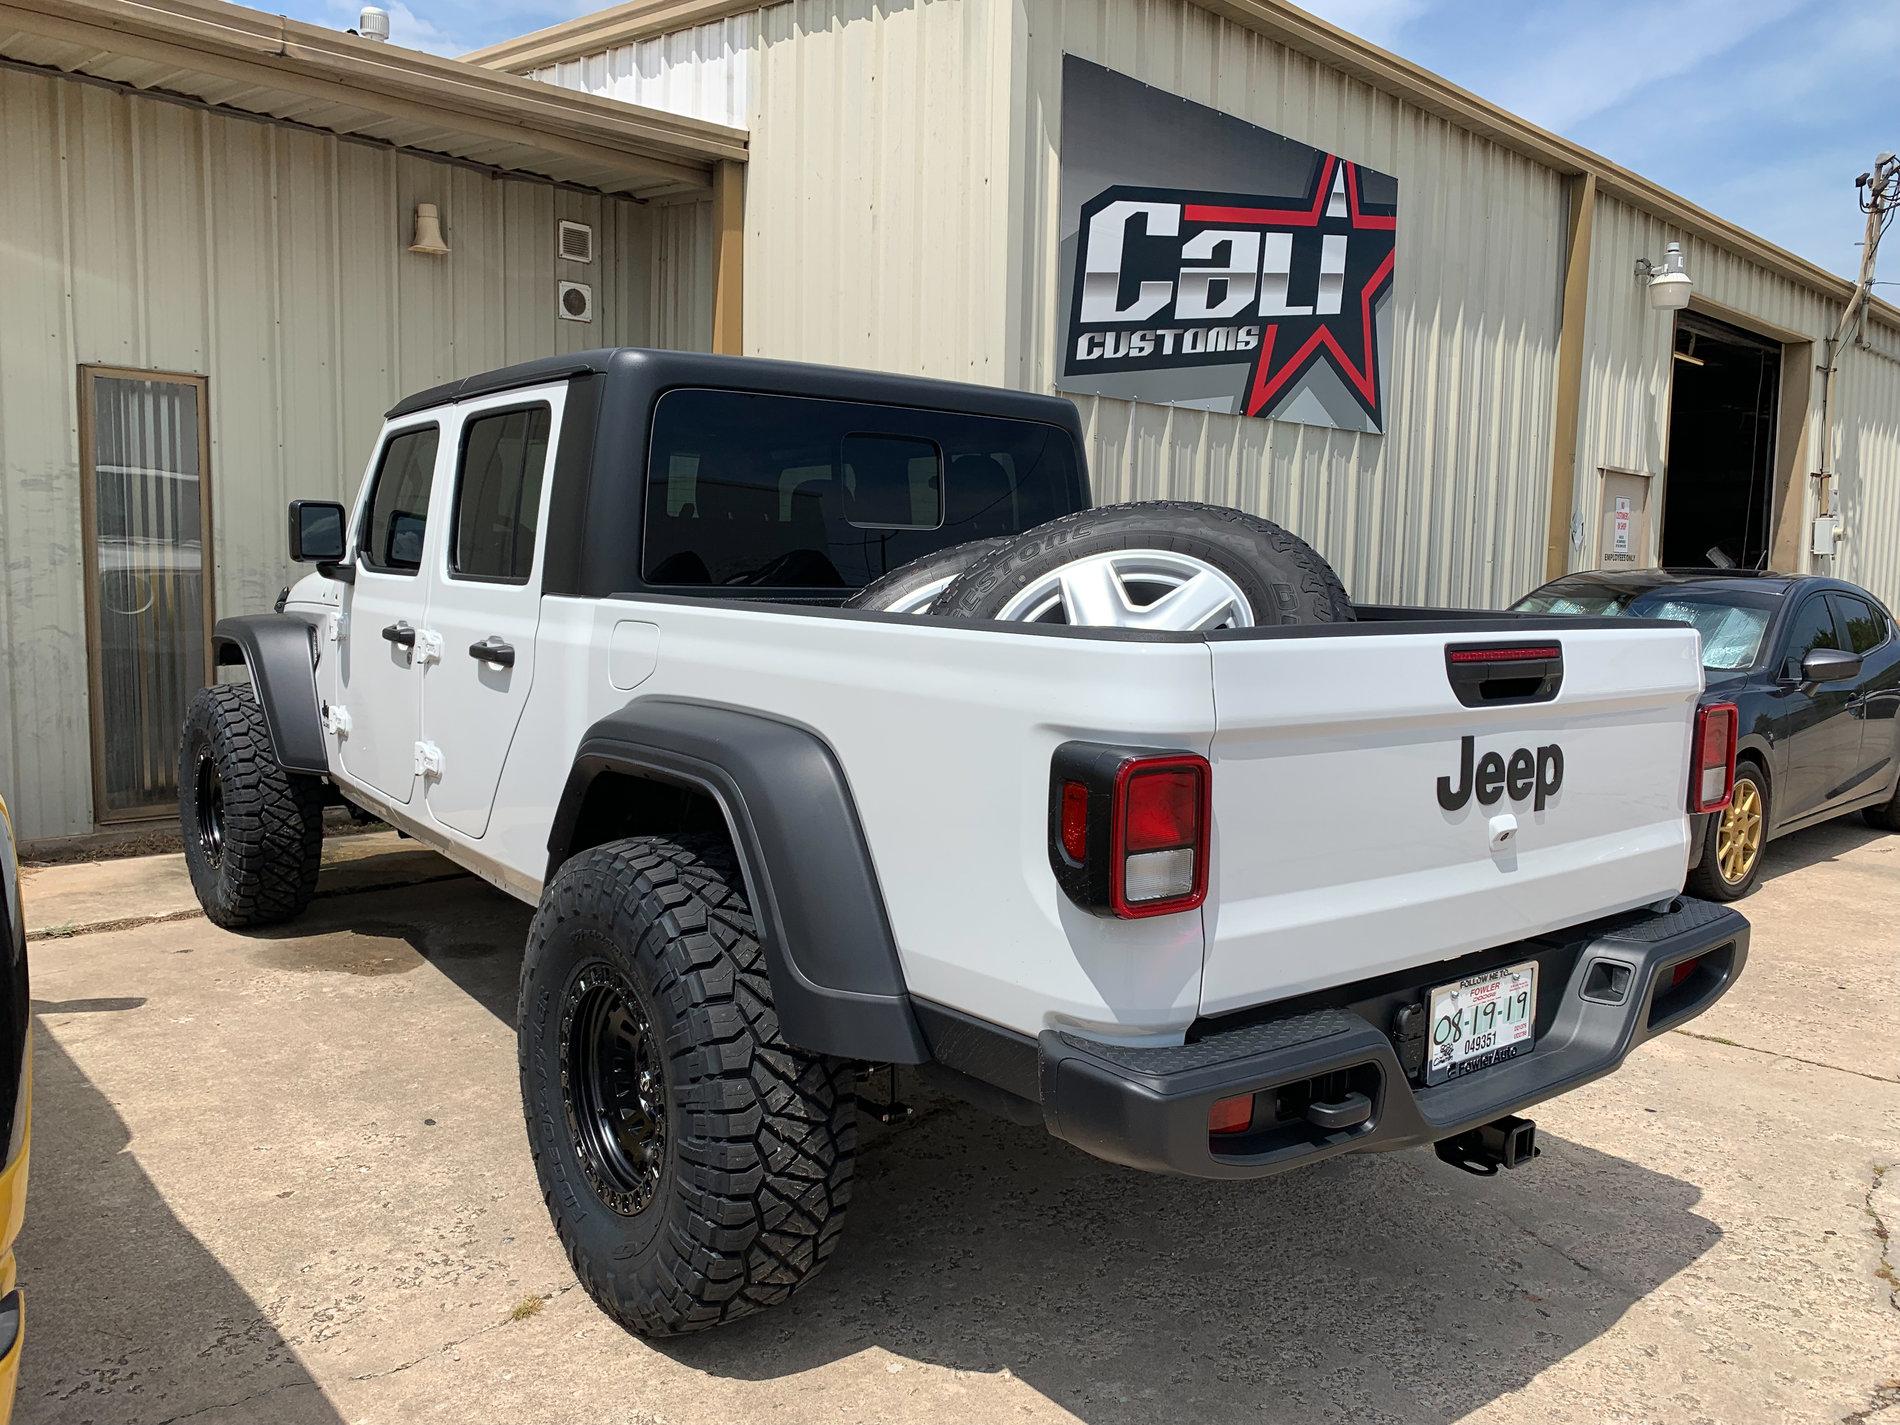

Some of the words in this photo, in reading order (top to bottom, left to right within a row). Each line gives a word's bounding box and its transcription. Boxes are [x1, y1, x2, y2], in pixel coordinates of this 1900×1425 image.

[1076, 325, 1260, 361] CUSTOMS
[1604, 553, 1626, 562] EMPLOYEES
[1626, 554, 1636, 562] ONLY
[1437, 735, 1564, 812] Jeep
[1460, 974, 1489, 989] FOLLOW
[1489, 971, 1499, 980] ME
[1470, 982, 1501, 997] FOWLER
[1464, 1031, 1498, 1055] 049351
